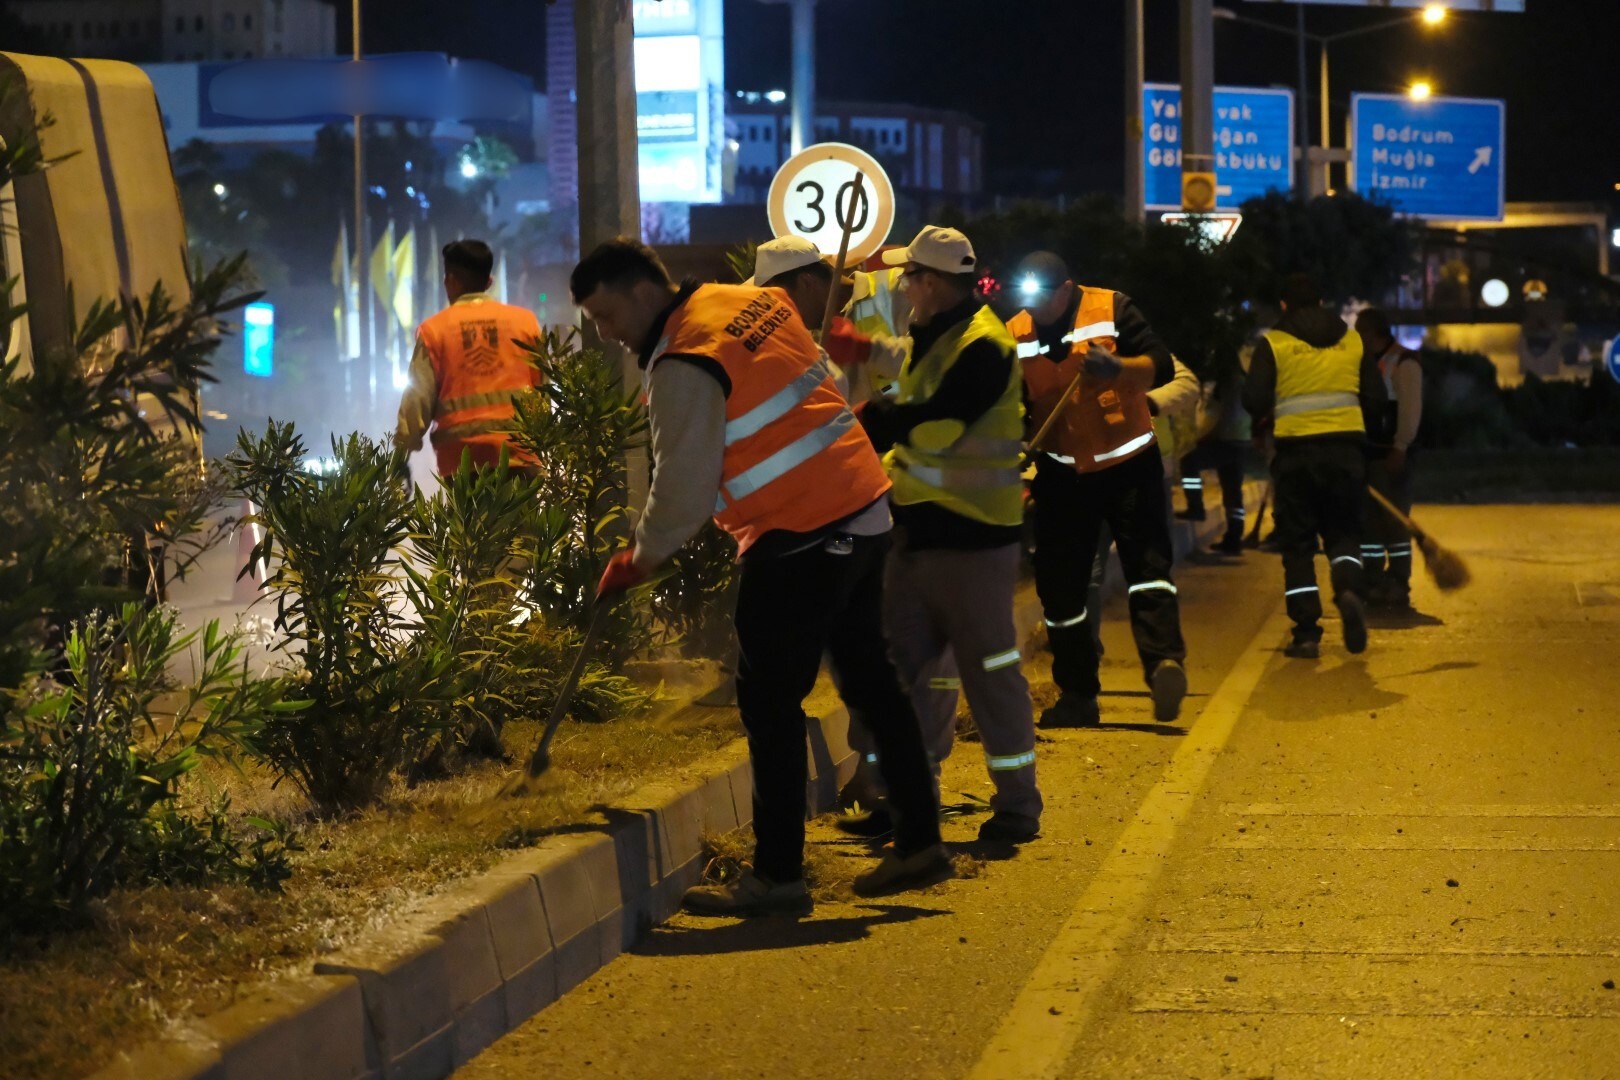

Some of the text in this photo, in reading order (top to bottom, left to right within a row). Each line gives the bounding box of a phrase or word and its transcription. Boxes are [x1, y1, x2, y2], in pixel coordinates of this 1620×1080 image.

[1151, 99, 1252, 121] Yalvak
[1372, 123, 1454, 144] Bodrum
[1148, 147, 1281, 171] Gölkbükü
[1372, 147, 1435, 171] Muğla
[1372, 166, 1427, 189] İzmir
[794, 180, 868, 233] 30
